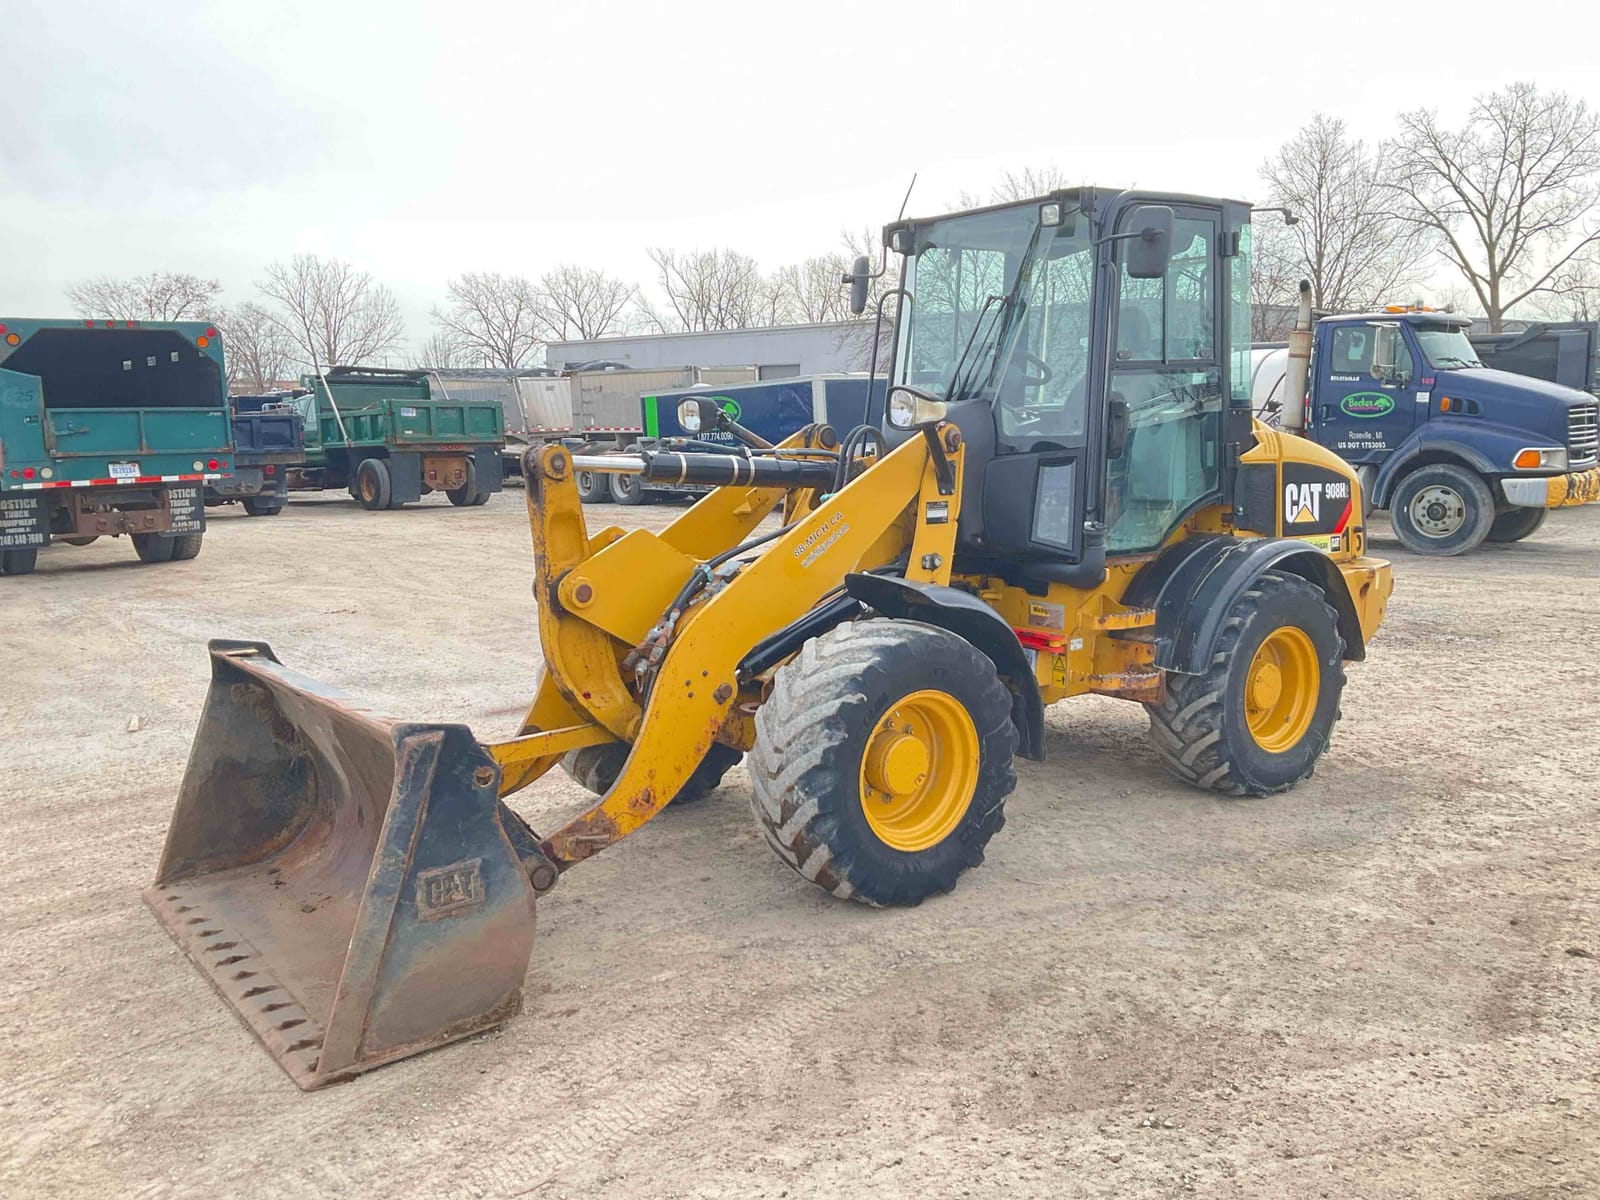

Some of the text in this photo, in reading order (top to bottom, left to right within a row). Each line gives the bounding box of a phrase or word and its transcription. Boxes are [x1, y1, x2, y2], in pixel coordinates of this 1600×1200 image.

[1337, 441, 1346, 449] US
[1347, 441, 1360, 449] DOT
[1285, 483, 1322, 524] CAT
